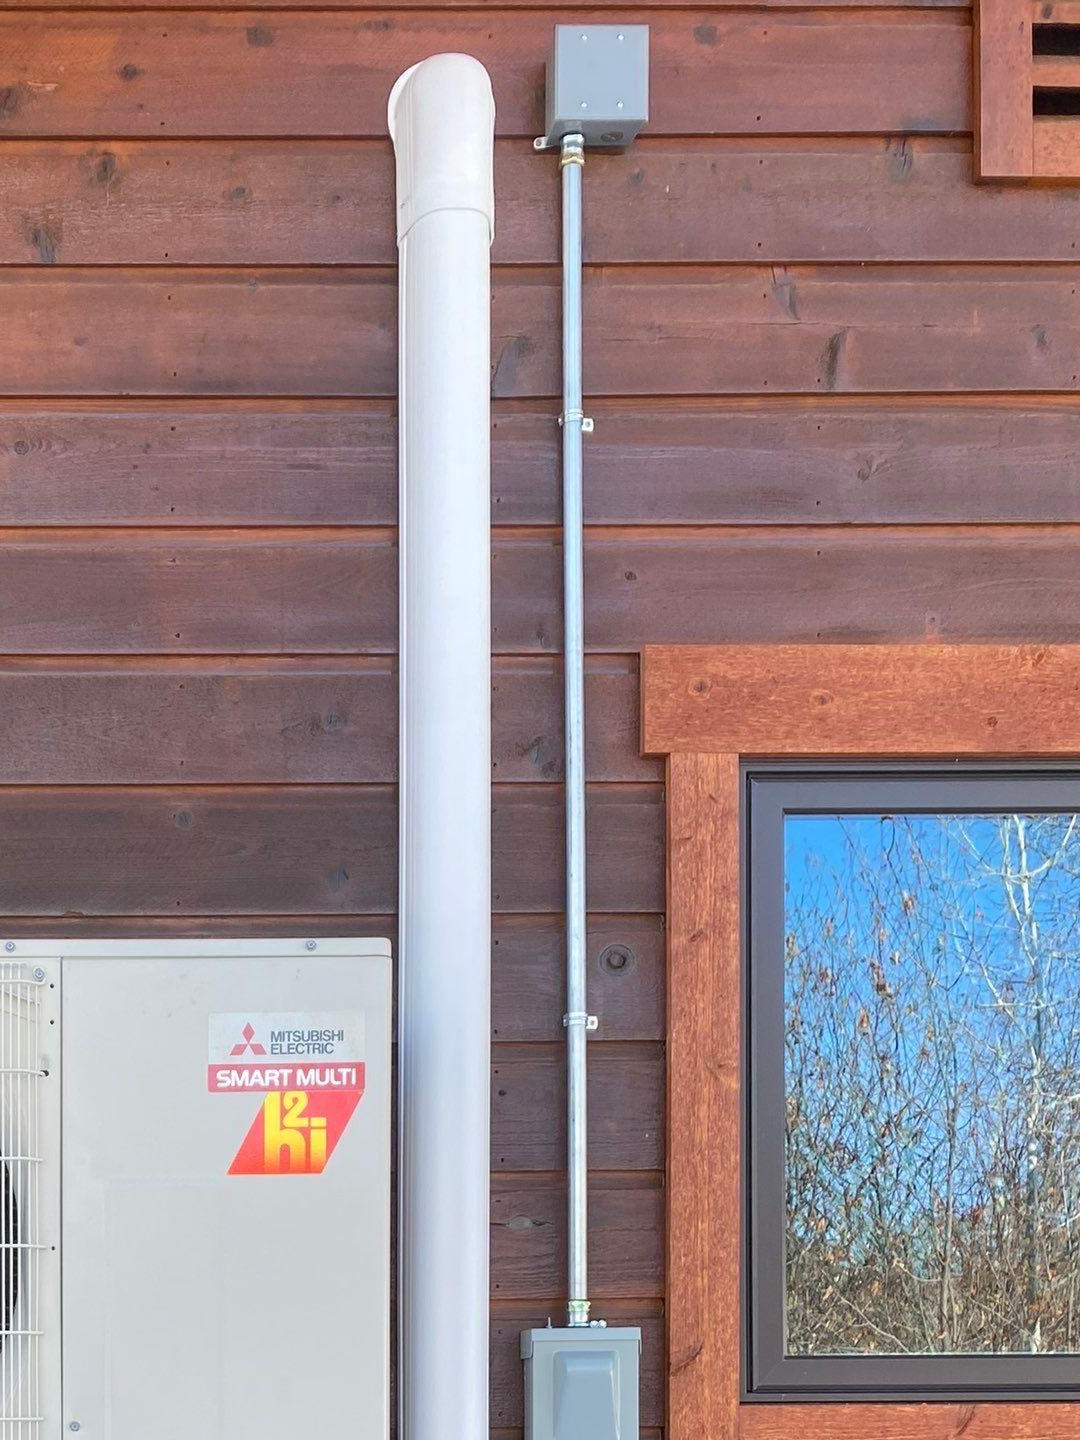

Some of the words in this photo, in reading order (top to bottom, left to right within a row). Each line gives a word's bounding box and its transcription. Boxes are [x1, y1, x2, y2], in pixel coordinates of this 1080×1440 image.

[270, 1029, 344, 1043] MITSUBISHI
[270, 1042, 334, 1055] ELECTRIC
[216, 1069, 293, 1087] SMART
[296, 1068, 356, 1086] MULTI
